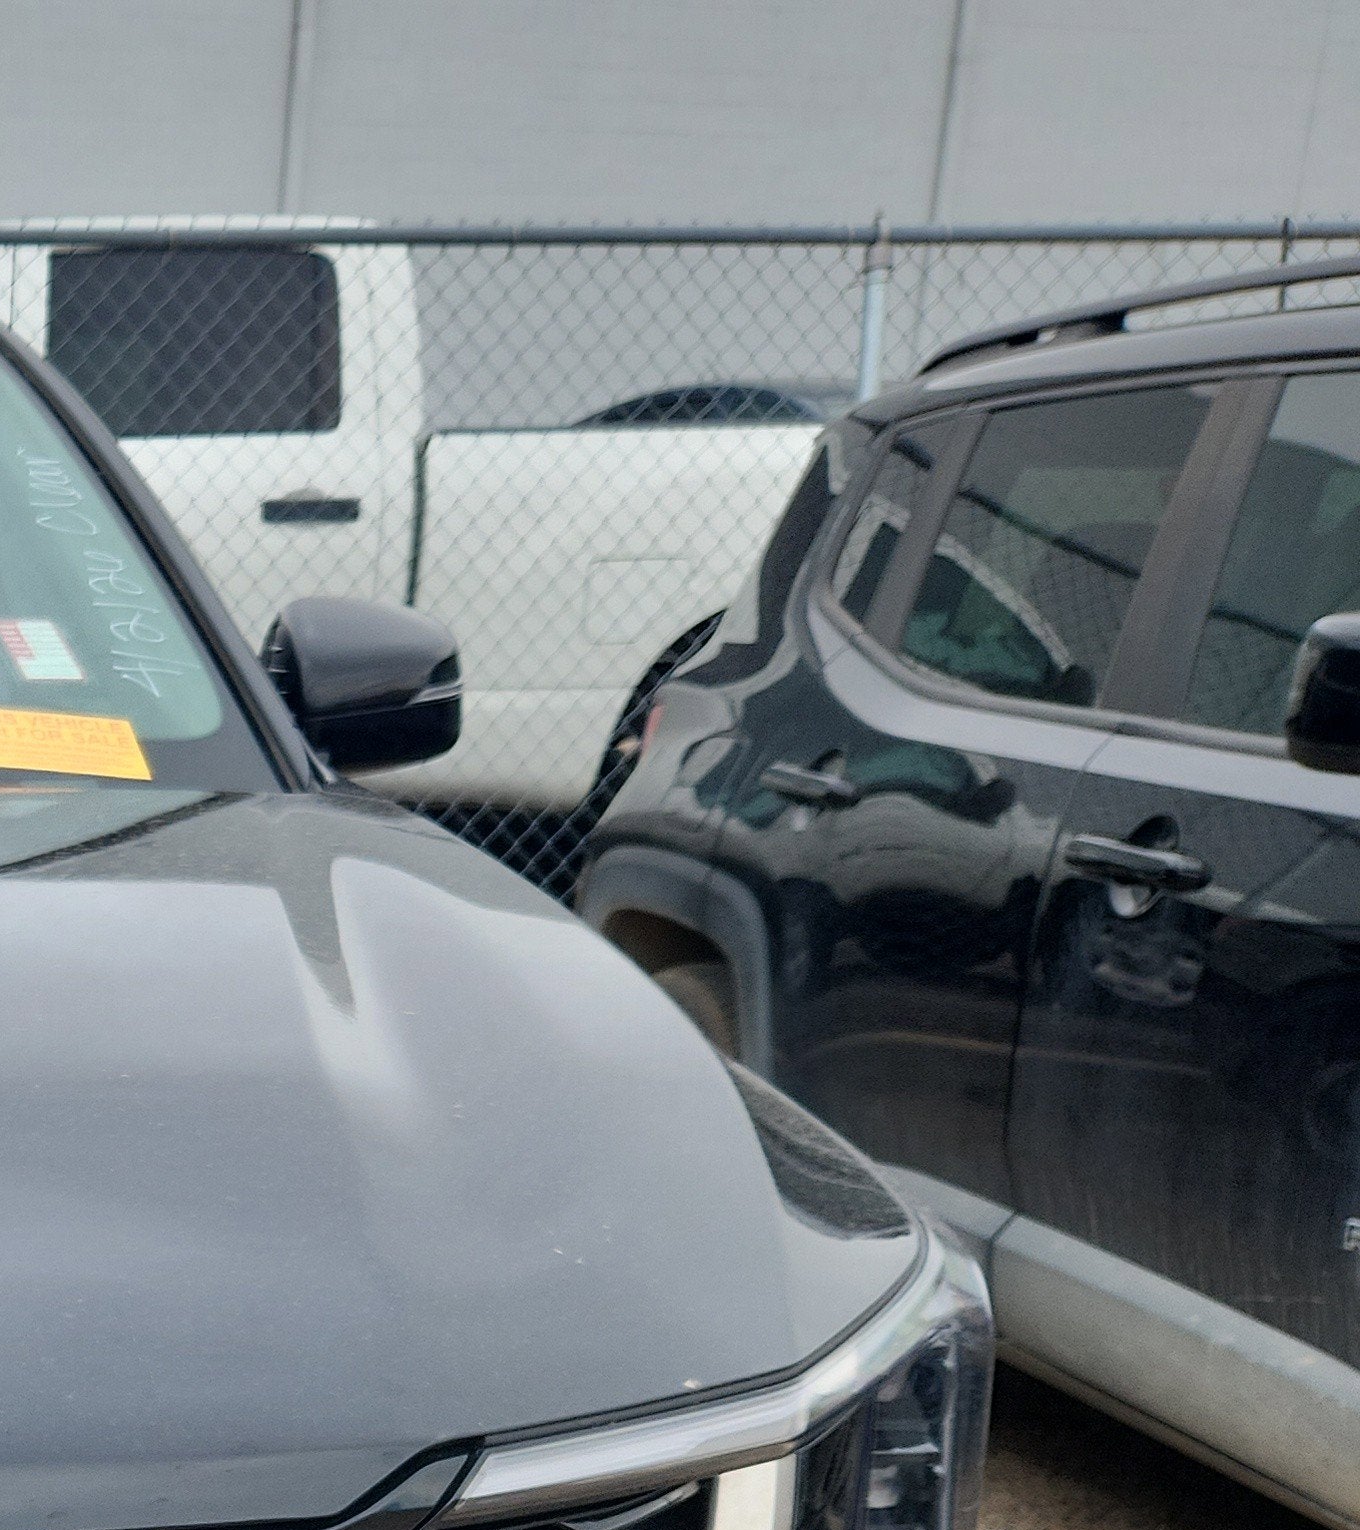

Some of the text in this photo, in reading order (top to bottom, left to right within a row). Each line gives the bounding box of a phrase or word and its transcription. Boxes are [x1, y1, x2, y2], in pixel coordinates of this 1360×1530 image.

[30, 714, 124, 735] VEHICLE
[17, 728, 64, 742] FOR
[72, 732, 131, 749] SALE
